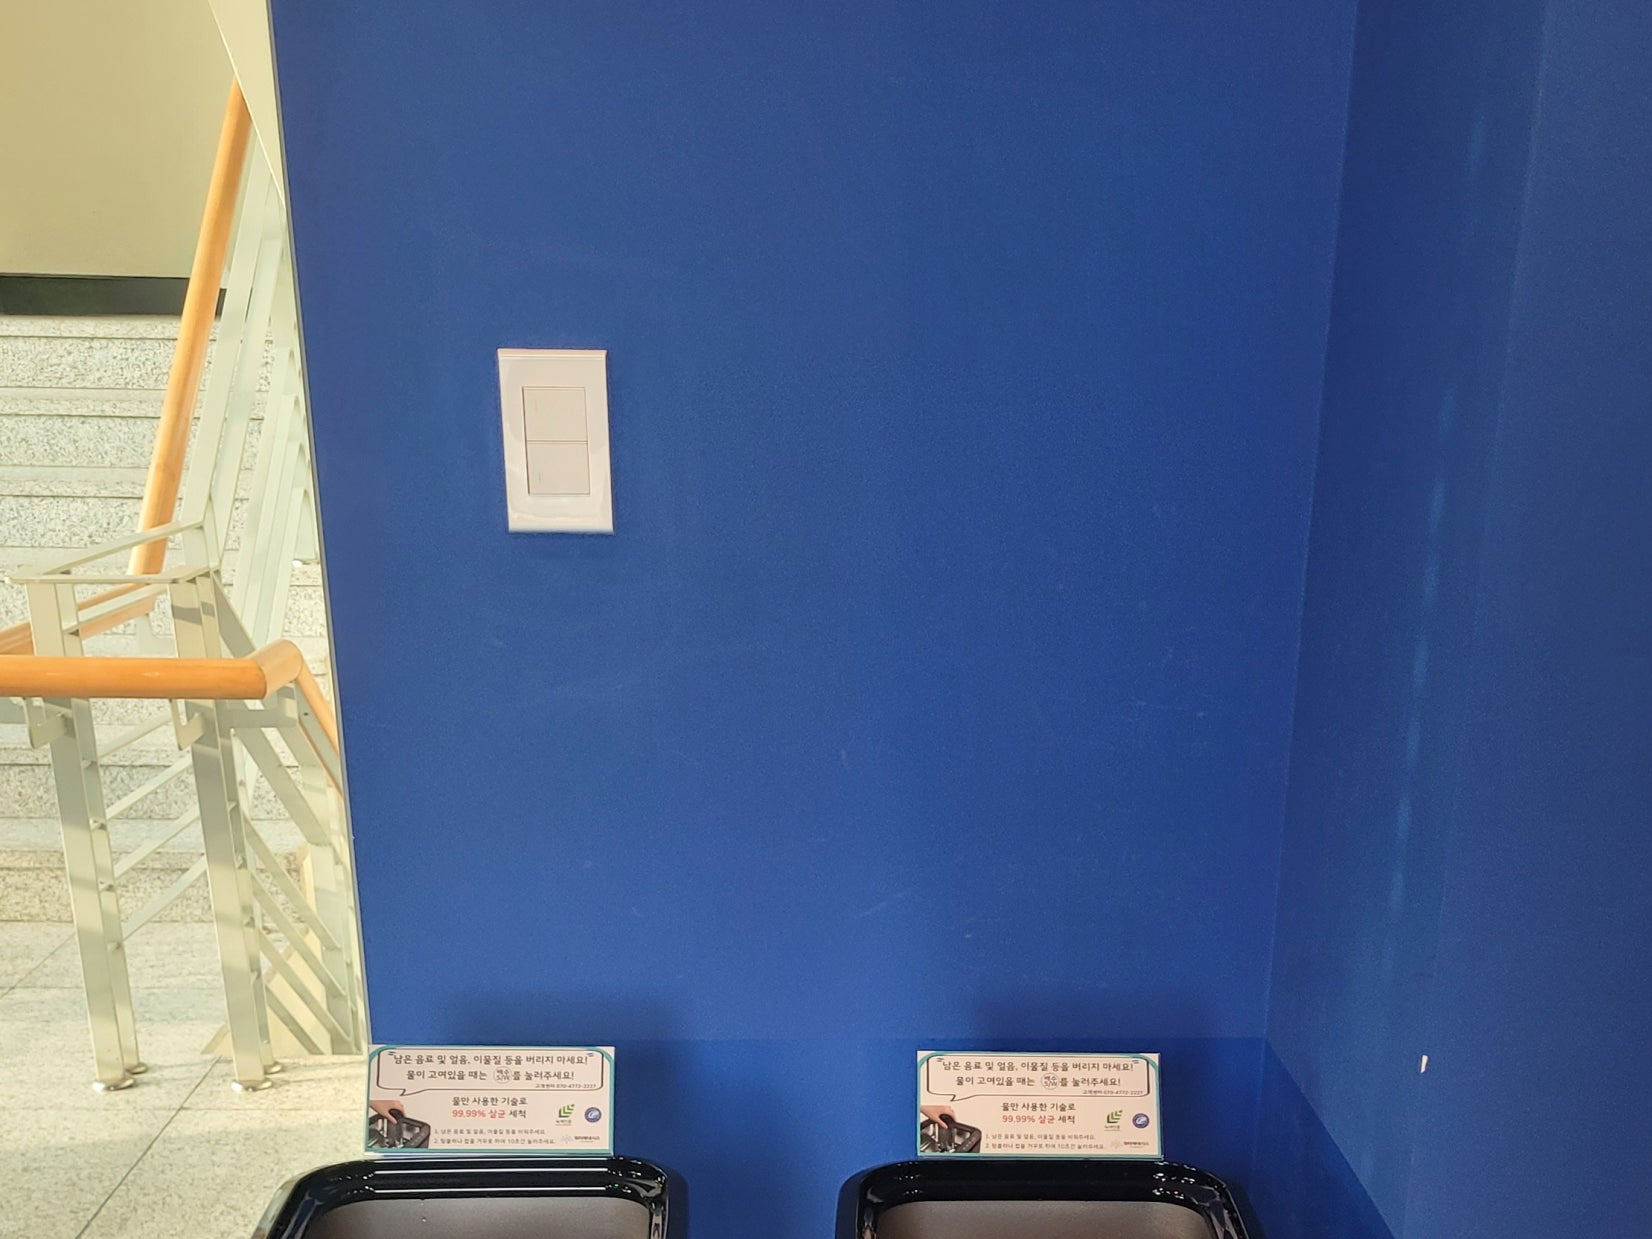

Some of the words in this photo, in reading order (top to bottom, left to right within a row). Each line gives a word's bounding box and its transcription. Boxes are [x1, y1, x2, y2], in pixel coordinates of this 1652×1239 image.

[415, 1055, 434, 1065] 음료
[437, 1055, 446, 1065] 및
[474, 1055, 501, 1066] 이물질
[504, 1056, 523, 1066] 등을
[526, 1056, 554, 1065] 버리지
[557, 1056, 588, 1065] 마세요!
[964, 1061, 982, 1071] 음료
[985, 1061, 994, 1071] 및
[1021, 1062, 1048, 1071] 이물질
[1051, 1062, 1069, 1072] 등을
[1072, 1062, 1100, 1071] 버리지
[1103, 1063, 1133, 1072] 마세요!
[406, 1070, 425, 1080] 물이
[427, 1070, 466, 1081] 고여있을
[468, 1071, 487, 1081] 때는
[524, 1071, 574, 1081] 눌러주세요!
[956, 1076, 974, 1086] 물이
[977, 1076, 1013, 1086] 고여있을
[1016, 1077, 1035, 1087] 때는
[1071, 1077, 1121, 1087] 눌러주세요!
[452, 1097, 469, 1106] 물만
[472, 1097, 498, 1106] 사용한
[501, 1097, 528, 1106] 기술로
[1001, 1102, 1019, 1112] 물만
[1022, 1102, 1047, 1112] 사용한
[1050, 1102, 1076, 1112] 기술로
[452, 1109, 486, 1118] 99.99%
[488, 1109, 506, 1119] 살균
[508, 1110, 527, 1119] 세척
[1002, 1115, 1036, 1123] 99.99%
[1038, 1115, 1055, 1124] 살균
[1058, 1115, 1076, 1124] 세척
